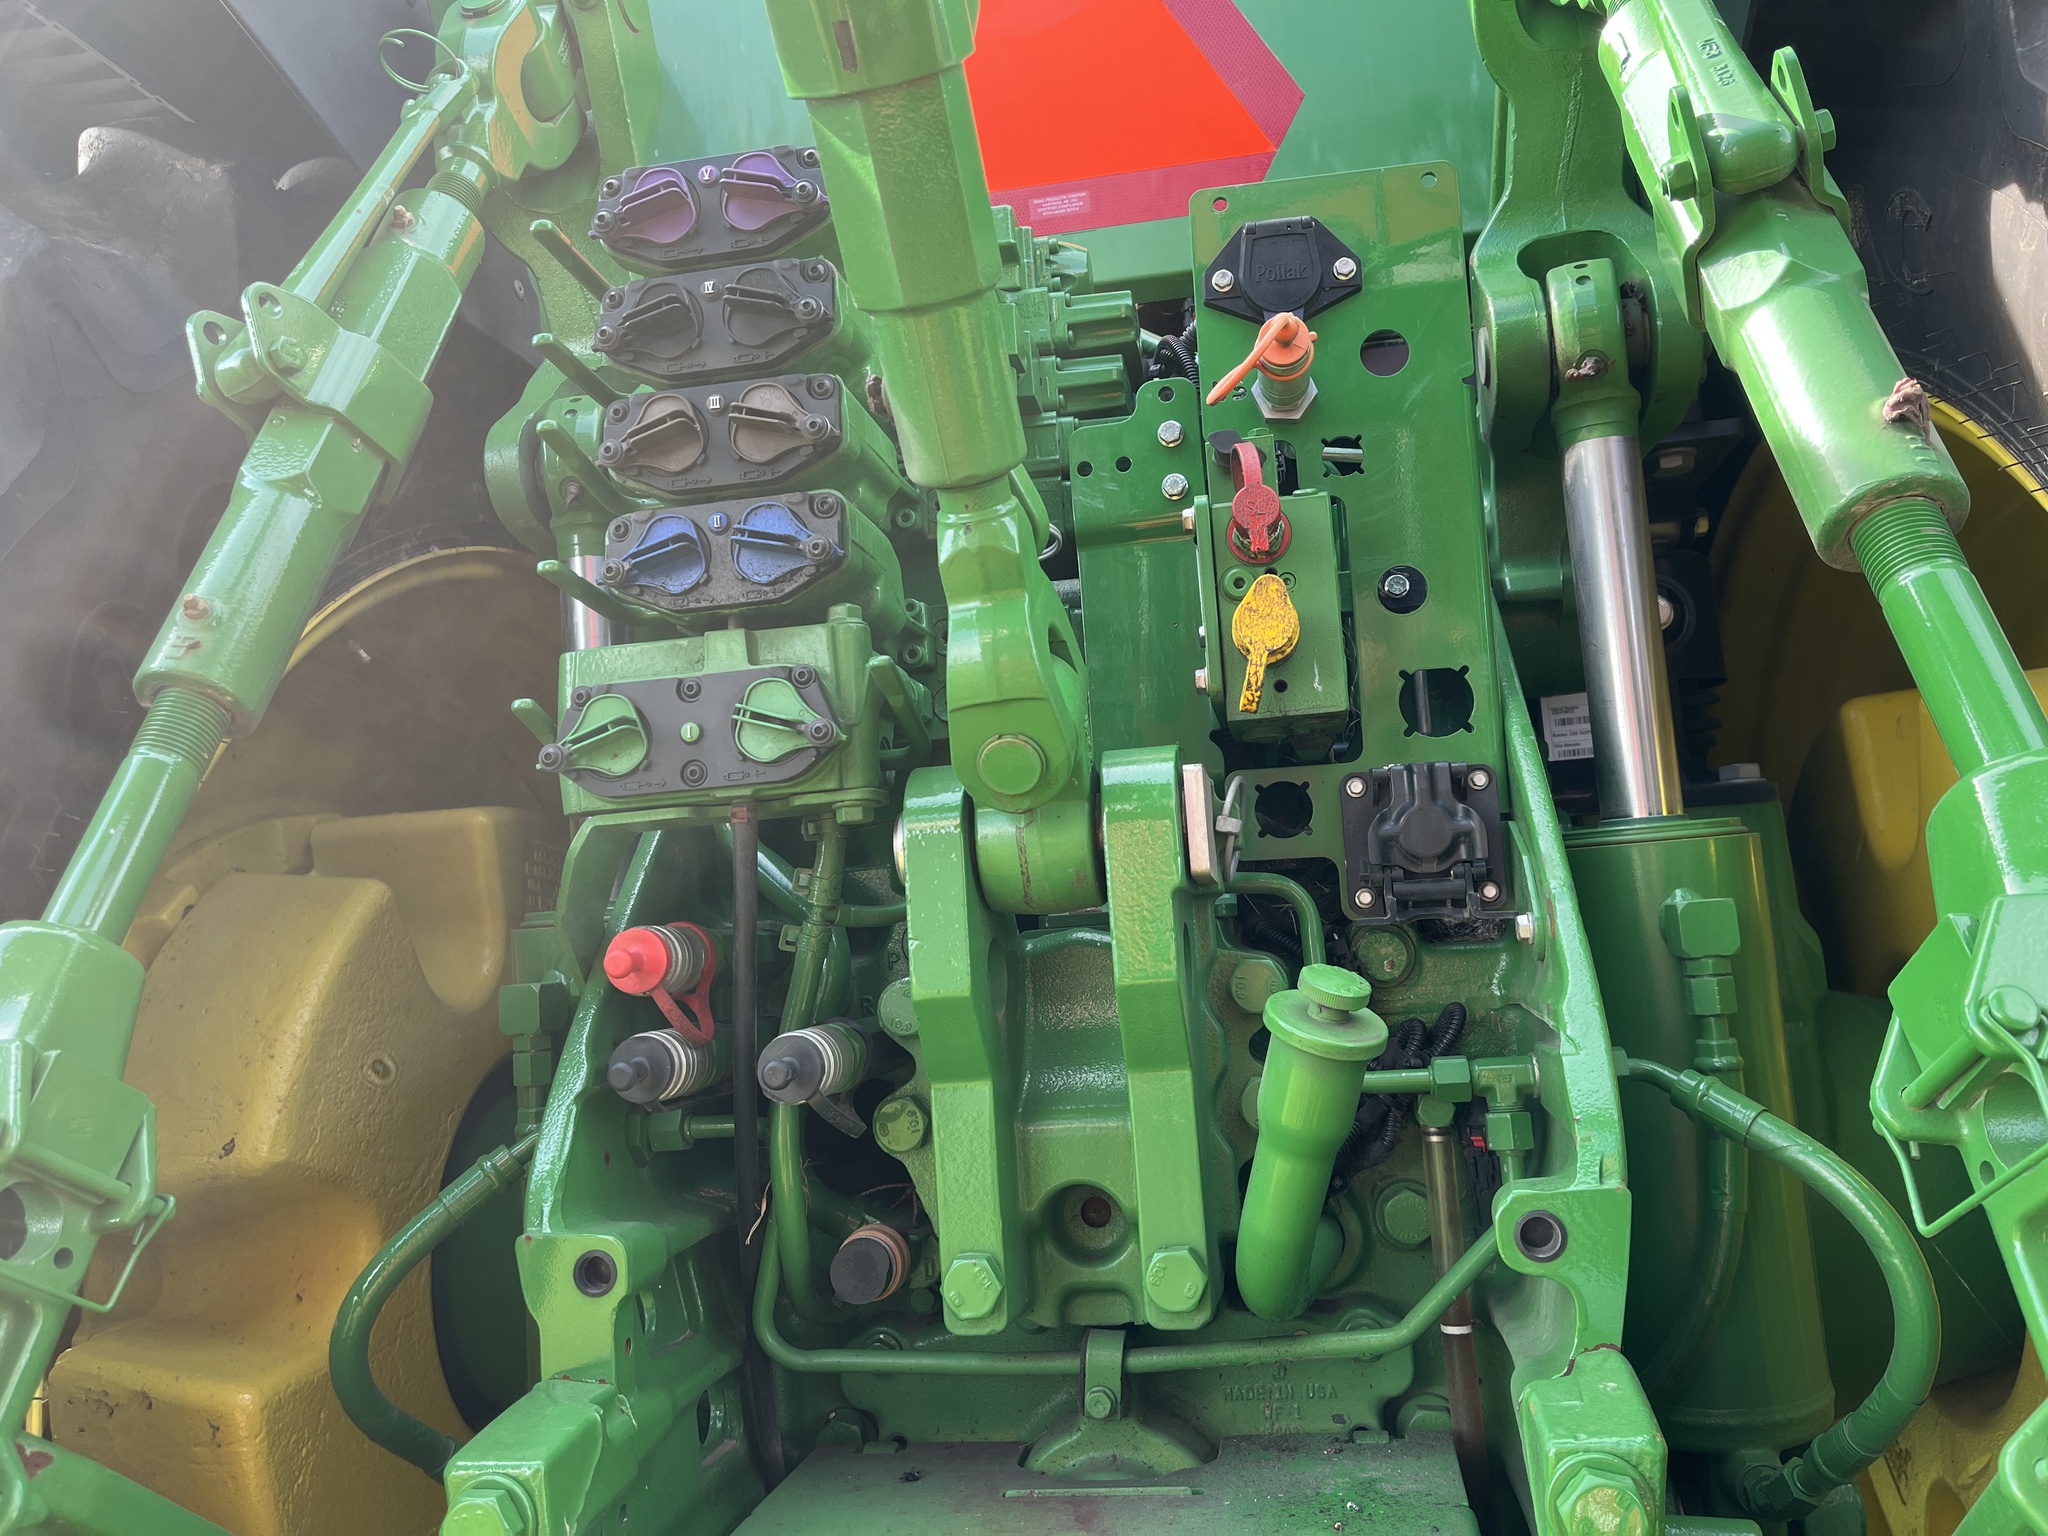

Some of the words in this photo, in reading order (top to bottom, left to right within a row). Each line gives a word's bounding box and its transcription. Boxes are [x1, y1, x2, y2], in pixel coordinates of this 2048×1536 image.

[702, 167, 712, 181] V
[1067, 191, 1087, 200] COMPANY
[1253, 260, 1309, 284] Pollak
[704, 280, 715, 294] IV
[708, 396, 721, 409] III
[713, 515, 722, 528] II
[887, 949, 901, 971] P
[1221, 1383, 1265, 1402] MADE
[1304, 1382, 1339, 1399] USA
